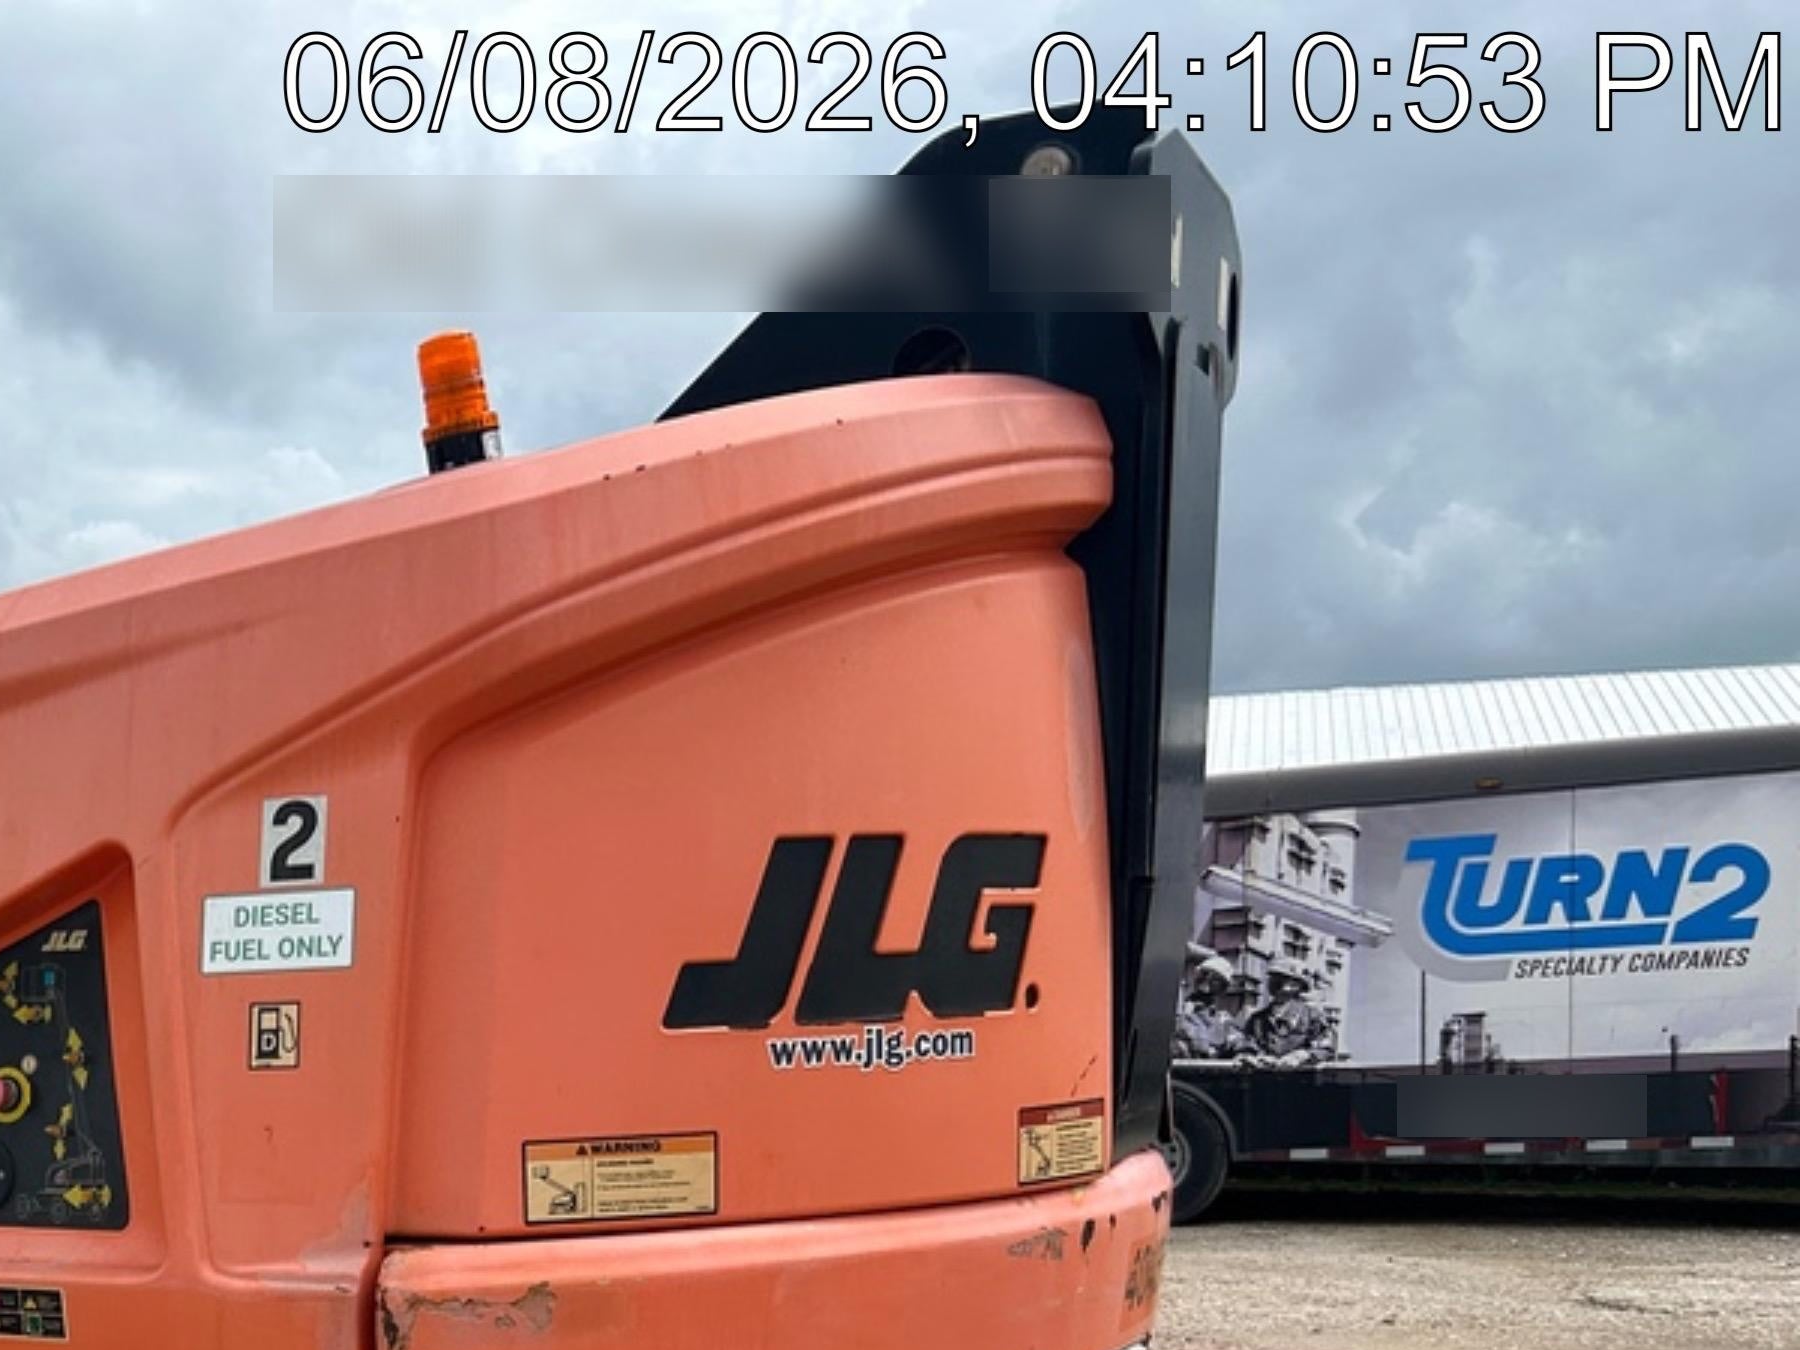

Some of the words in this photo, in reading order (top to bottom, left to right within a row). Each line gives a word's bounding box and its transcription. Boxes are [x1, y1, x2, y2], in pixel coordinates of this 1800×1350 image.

[270, 800, 319, 882] 2
[1405, 834, 1772, 955] TURN2
[234, 903, 320, 929] DIESEL
[662, 832, 1046, 1029] JLG
[41, 928, 88, 953] JLG
[210, 939, 271, 963] FUEL
[278, 934, 344, 959] ONLY
[1514, 953, 1623, 979] SPECIALTY
[1627, 946, 1750, 973] COMPANIES
[770, 1028, 974, 1068] www.jlg.com
[591, 1140, 662, 1153] WARNING
